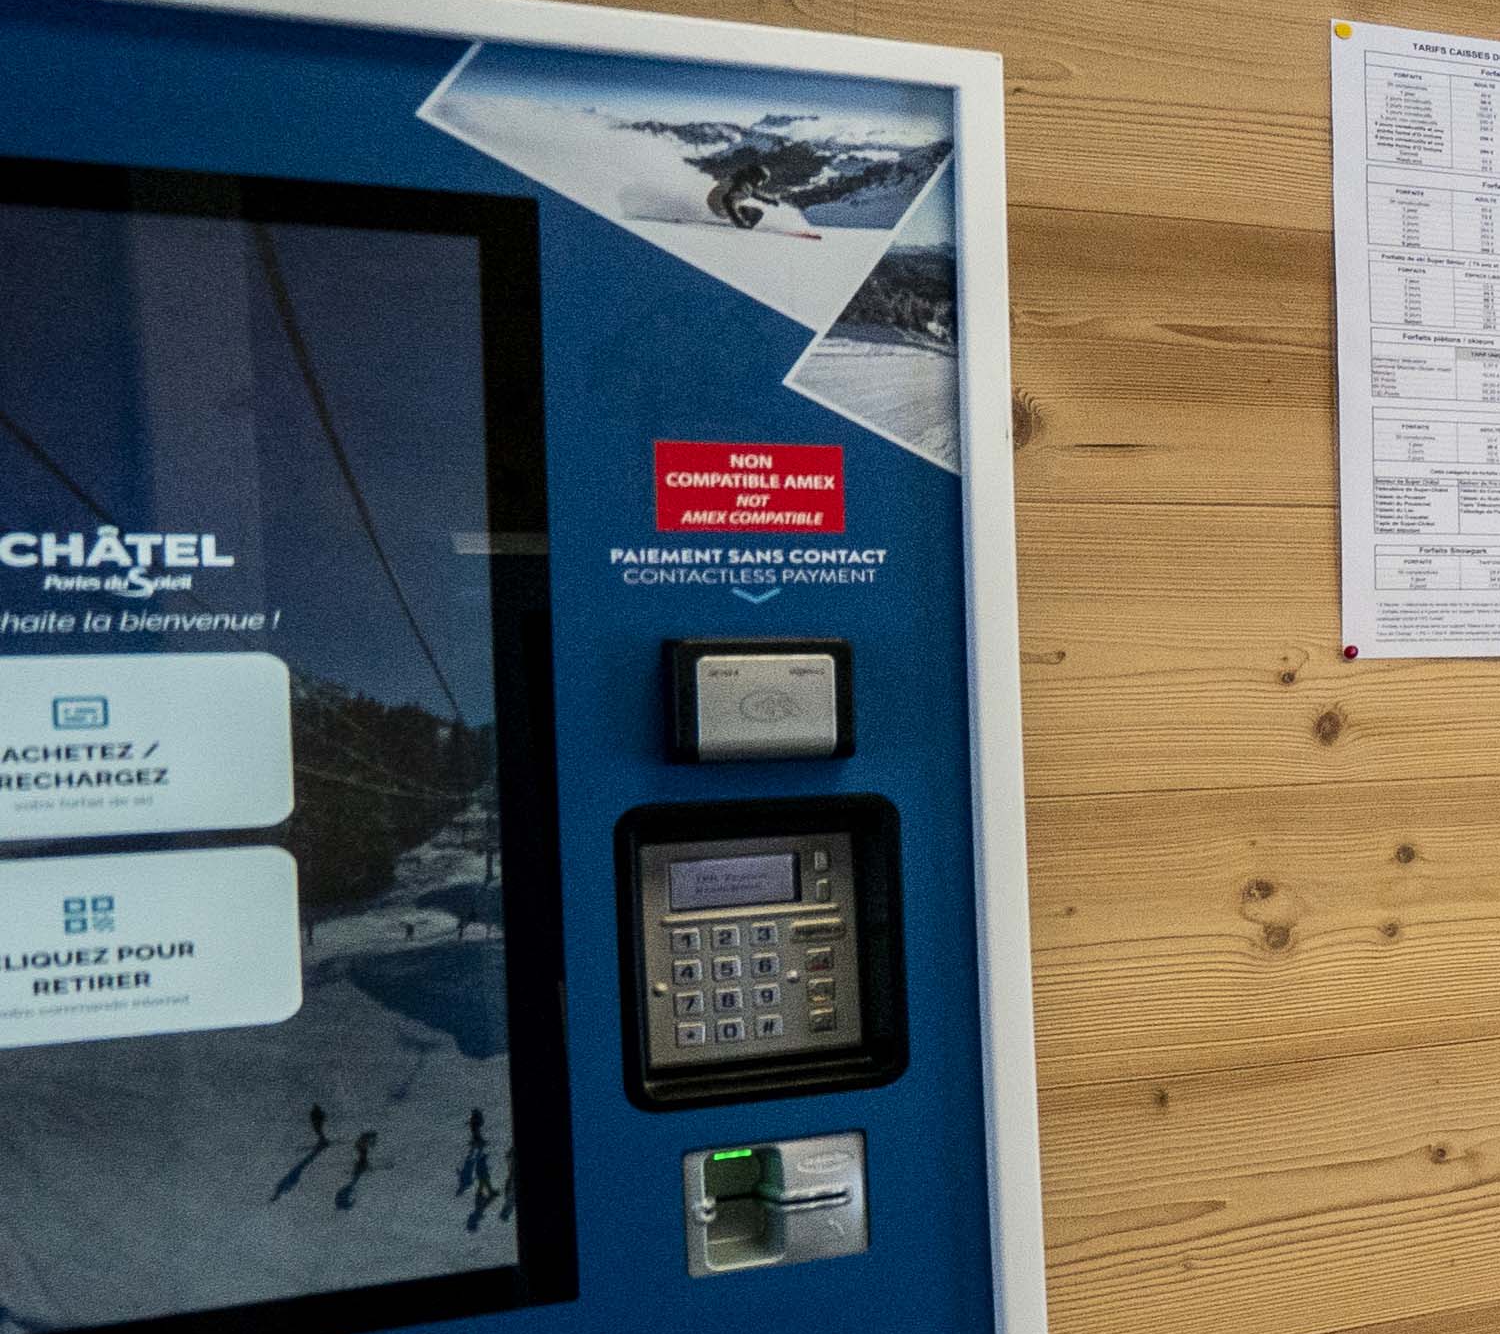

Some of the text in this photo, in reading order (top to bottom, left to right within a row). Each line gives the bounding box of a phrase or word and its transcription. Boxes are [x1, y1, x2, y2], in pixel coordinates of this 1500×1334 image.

[1413, 43, 1447, 55] TARIFS
[1449, 48, 1490, 60] CAISSES
[730, 454, 773, 469] NON
[665, 472, 836, 490] COMPATIBLE AMEX
[736, 494, 770, 508] NOT
[681, 511, 824, 526] AMEX COMPATIBLE
[0, 525, 235, 567] CHÂTEL
[610, 548, 886, 564] PAIEMENT SANS CONTACT
[623, 568, 876, 585] CONTACTLESS PAYMENT
[84, 611, 110, 632] la
[120, 611, 265, 632] bienvenue
[272, 610, 281, 630] !
[3, 743, 135, 763] ACHETEZ
[0, 768, 169, 791] RECHARGEZ
[118, 940, 195, 961] POUR
[33, 971, 152, 997] RETIRER
